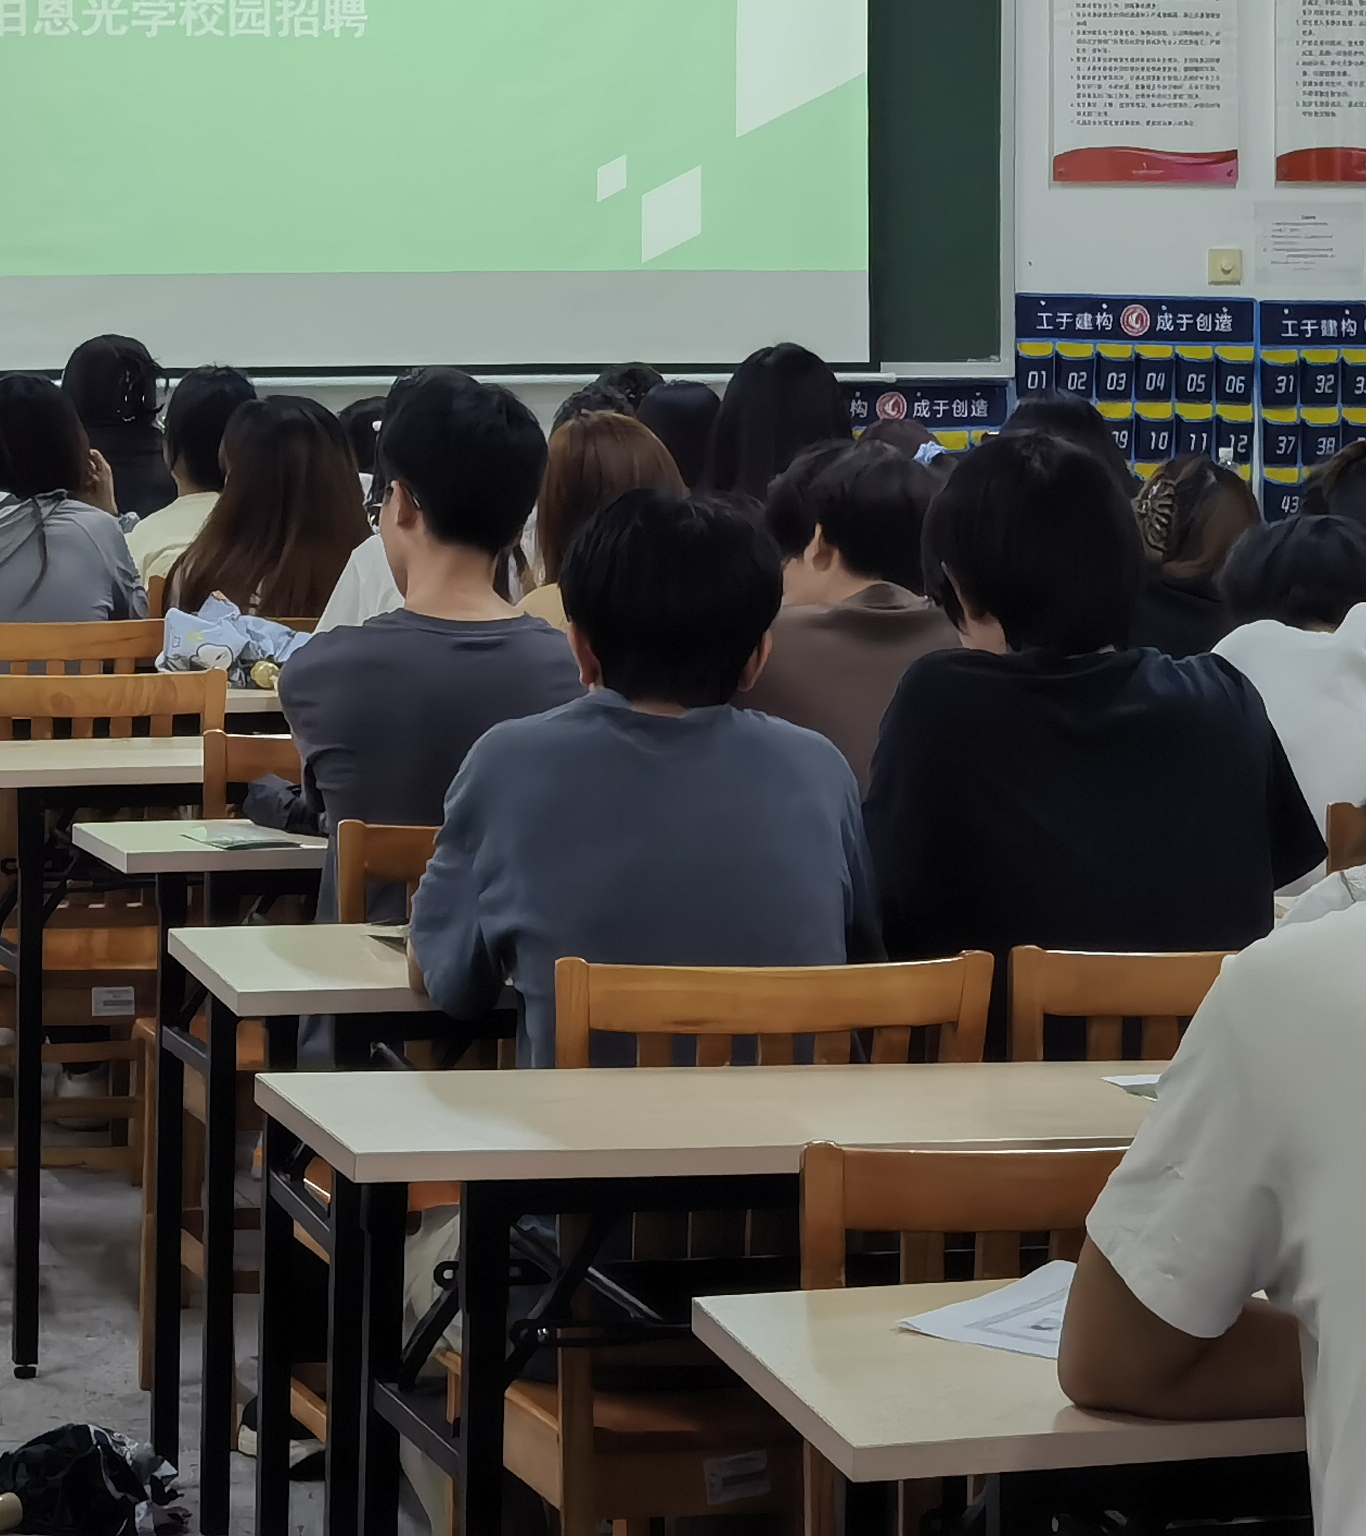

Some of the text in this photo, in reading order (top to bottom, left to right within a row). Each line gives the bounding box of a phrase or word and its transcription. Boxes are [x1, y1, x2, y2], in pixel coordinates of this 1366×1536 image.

[1036, 311, 1233, 332] 工于建构 成于创造
[1281, 318, 1357, 337] 工于建构
[1027, 370, 1046, 389] 01
[1067, 371, 1087, 390] 02
[1106, 372, 1127, 391] 03
[1145, 372, 1166, 391] 04
[1186, 373, 1206, 392] 05
[1225, 375, 1246, 394] 06
[1275, 375, 1294, 394] 31
[1314, 374, 1334, 394] 32
[912, 398, 989, 418] 成于创造
[1150, 431, 1168, 450] 10
[1189, 432, 1207, 452] 11
[1229, 434, 1247, 453] 12
[1276, 435, 1296, 455] 37
[1316, 437, 1335, 455] 38
[1281, 496, 1300, 513] 43
